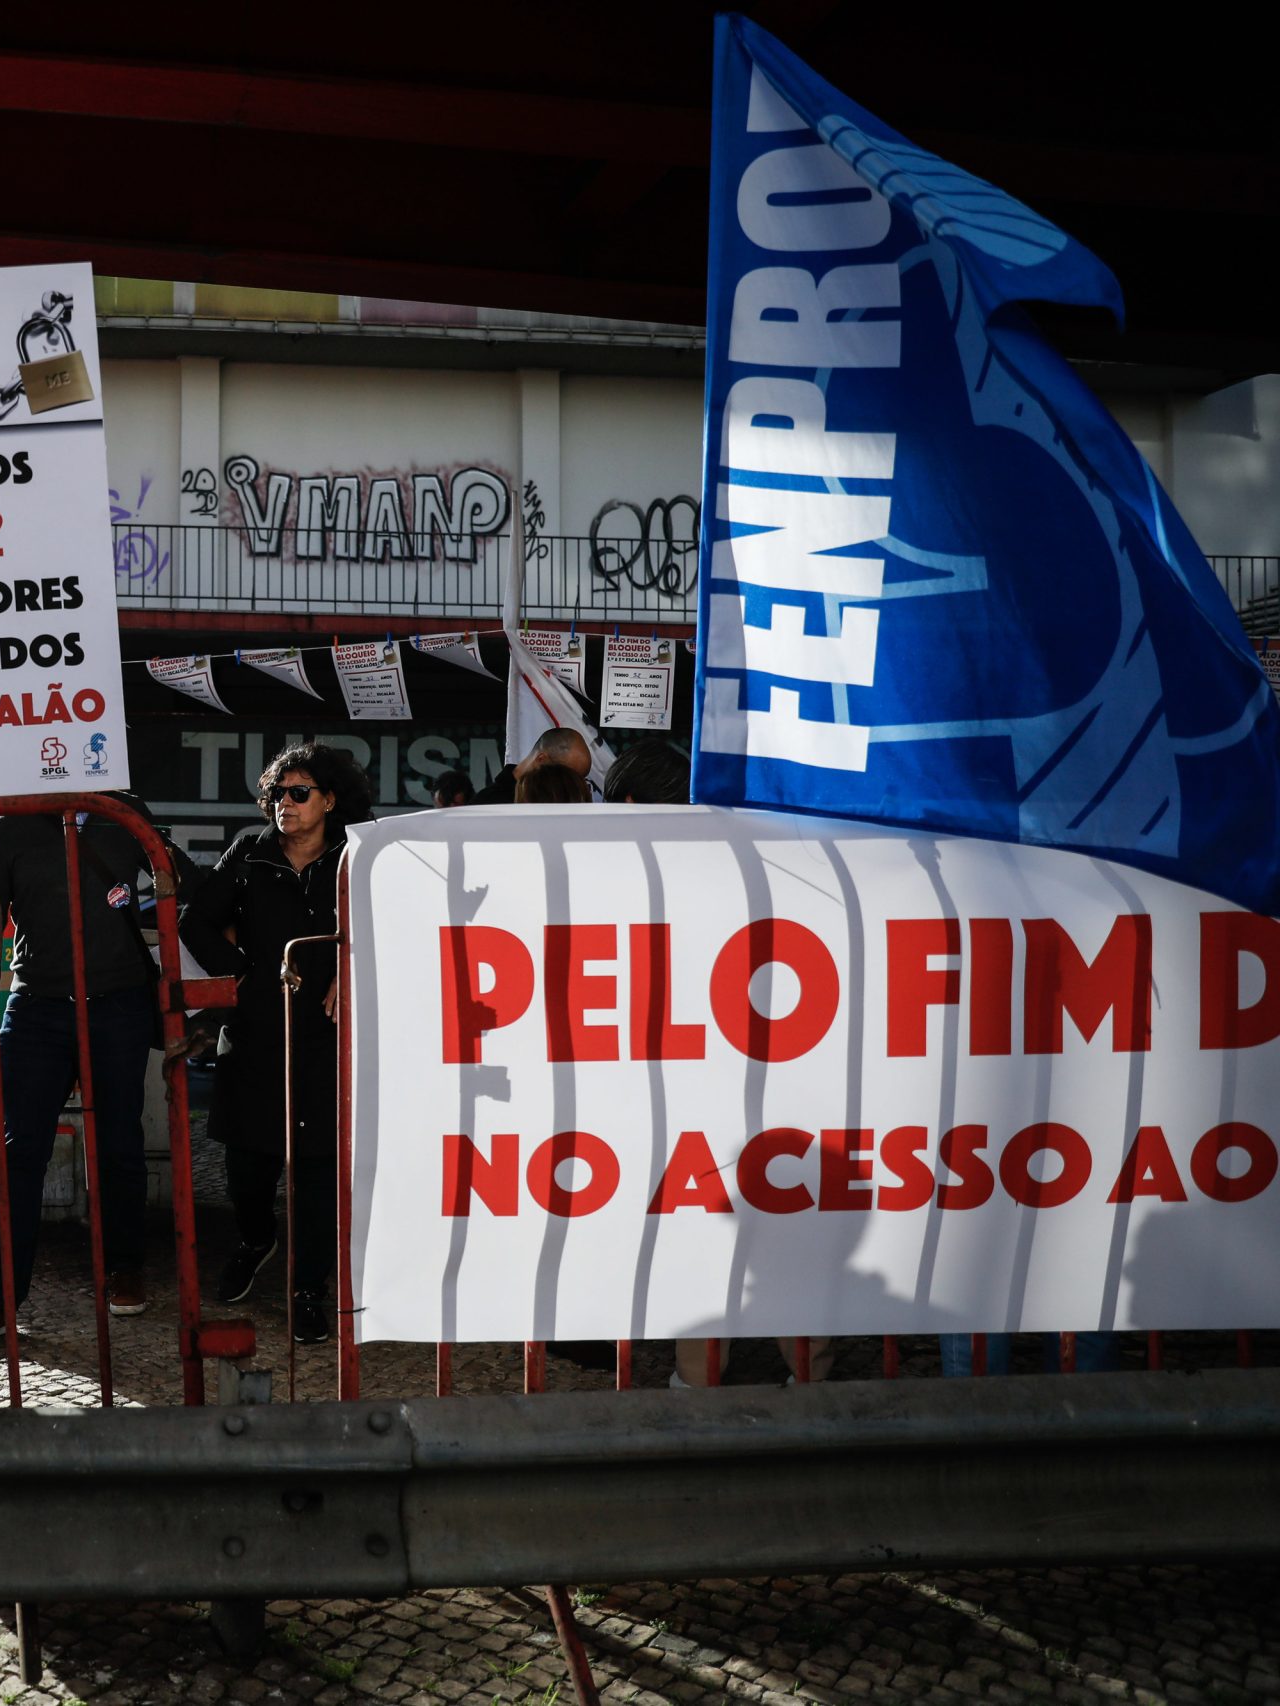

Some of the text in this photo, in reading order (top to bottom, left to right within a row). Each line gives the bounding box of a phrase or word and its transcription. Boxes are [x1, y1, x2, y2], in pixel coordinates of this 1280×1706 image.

[608, 644, 651, 652] BLOQUEIO
[336, 650, 376, 660] BLOQUEIO
[150, 657, 188, 669] BLOQUEIO
[42, 767, 68, 775] SPGL
[439, 917, 839, 1063] PELO
[886, 914, 1153, 1057] FIM
[441, 1121, 1279, 1218] NO ACESSO AO
